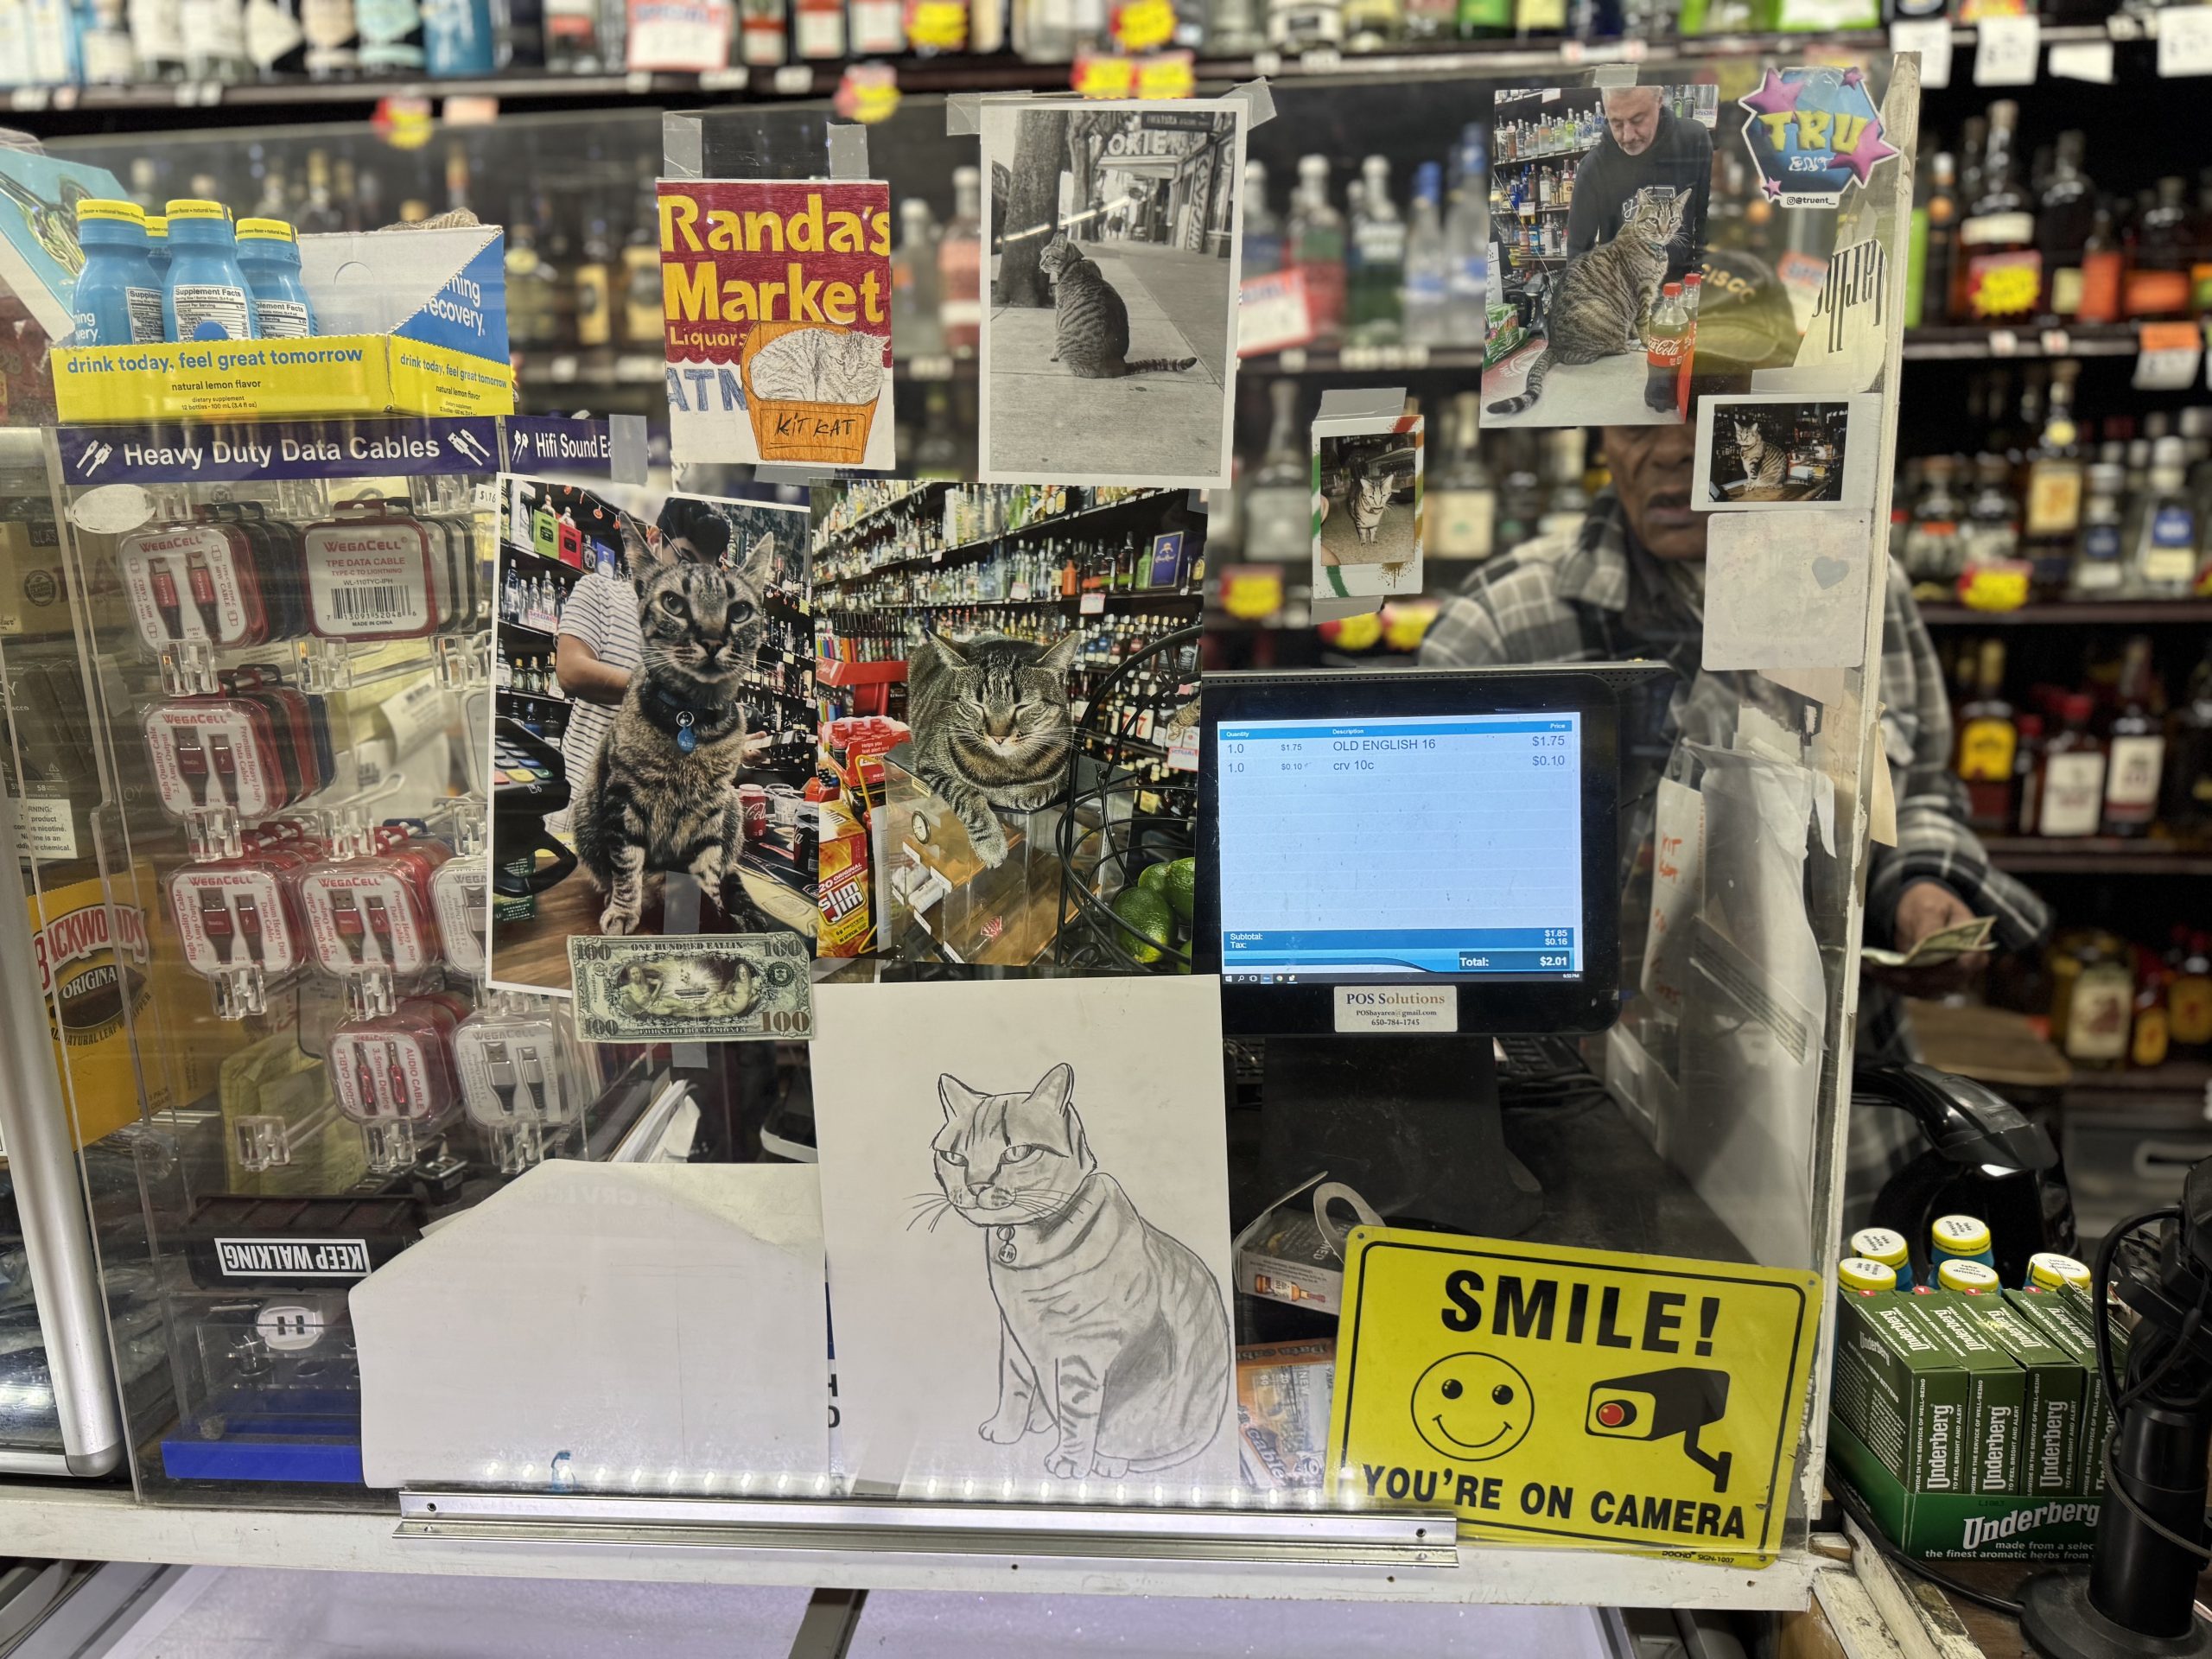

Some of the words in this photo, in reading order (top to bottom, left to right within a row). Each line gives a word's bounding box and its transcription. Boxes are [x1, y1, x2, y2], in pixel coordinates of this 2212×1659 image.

[1758, 111, 1868, 155] TRU
[658, 194, 890, 257] Randa's
[175, 288, 220, 298] Supplement
[222, 289, 242, 297] Facts
[662, 261, 885, 325] Market
[286, 304, 304, 313] Facts
[670, 327, 747, 352] Liquors
[67, 356, 115, 374] drink
[118, 353, 175, 373] today,
[178, 351, 213, 369] feel
[218, 349, 265, 372] great
[270, 347, 364, 366] tomorrow
[400, 353, 422, 369] drink
[423, 359, 445, 377] today,
[446, 364, 460, 378] feel
[460, 370, 477, 382] great
[478, 374, 507, 389] tomorrow
[172, 381, 204, 391] natural
[206, 380, 233, 390] lemon
[235, 379, 262, 389] flavor
[435, 385, 453, 395] natural
[453, 387, 467, 397] lemon
[467, 391, 481, 401] flavor
[213, 395, 245, 404] supplement
[124, 443, 203, 471] Heavy
[213, 440, 272, 469] Duty
[282, 438, 341, 462] Data
[350, 434, 442, 461] Cables
[536, 432, 559, 458] Hifi
[561, 433, 600, 460] Sound
[326, 559, 345, 568] TPE
[346, 558, 372, 567] DATA
[373, 557, 406, 566] CABLE
[149, 726, 160, 750] Cable
[1227, 743, 1244, 754] 1.0
[1281, 743, 1302, 752] $1.75
[1333, 740, 1359, 752] OLD
[1363, 738, 1418, 752] ENGLISH
[1422, 738, 1436, 750] 16
[1532, 734, 1566, 748] $1.75
[155, 750, 168, 780] Quality
[1227, 762, 1244, 773] 1.0
[1281, 762, 1303, 772] $0.10
[1333, 761, 1351, 772] crv
[1354, 760, 1375, 772] 10c
[1532, 755, 1566, 767] $0.10
[161, 779, 172, 801] High
[819, 880, 834, 893] 20
[833, 862, 862, 880] ORIGINAL
[181, 912, 194, 941] Quality
[1230, 932, 1264, 942] Subtotal:
[1545, 929, 1568, 938] $1.85
[187, 941, 197, 961] High
[577, 944, 612, 961] 100
[765, 941, 804, 957] 100
[1230, 941, 1247, 950] Tax:
[1545, 938, 1568, 947] $0.16
[1460, 957, 1490, 968] Total:
[1539, 956, 1568, 967] $2.01
[1346, 993, 1375, 1006] POS
[1378, 992, 1446, 1005] Solutions
[586, 1020, 619, 1035] 100
[761, 1011, 810, 1032] 100
[1356, 1008, 1438, 1019] POSbayarea@gmail.com
[1371, 1018, 1421, 1027] 650-784-1745
[337, 1047, 350, 1079] CABLE
[405, 1047, 418, 1078] AUDIO
[412, 1079, 425, 1109] CABLE
[223, 1245, 315, 1270] WALKING
[316, 1246, 364, 1270] KEEP
[1440, 1269, 1721, 1357] SMILE!
[2019, 1299, 2045, 1319] GERMANY
[1875, 1310, 1930, 1351] Underberg
[1929, 1309, 1988, 1351] Underberg
[1982, 1310, 2043, 1348] Underberg
[2042, 1306, 2096, 1349] Underberg
[1859, 1331, 1891, 1367] Underberg
[2056, 1330, 2084, 1355] IMPORTED
[2087, 1427, 2095, 1453] SERVICE
[2091, 1378, 2101, 1417] WELL-BEING
[1246, 1427, 1287, 1479] cable
[1926, 1404, 1955, 1490] Underberg
[1982, 1406, 2012, 1491] Underberg
[2039, 1401, 2069, 1487] Underberg
[1362, 1464, 1503, 1510] YOU'RE
[1521, 1482, 1574, 1520] ON
[1590, 1491, 1745, 1540] CAMERA
[1962, 1502, 2101, 1550] Underberg
[1925, 1549, 1943, 1558] the
[1946, 1549, 1977, 1558] finest
[1980, 1550, 2027, 1559] aromatic
[2030, 1550, 2060, 1560] herbs
[2063, 1550, 2090, 1560] from
[2029, 1541, 2055, 1550] from
[2067, 1541, 2094, 1550] selec
[1697, 1554, 1735, 1563] SIGN-1007
